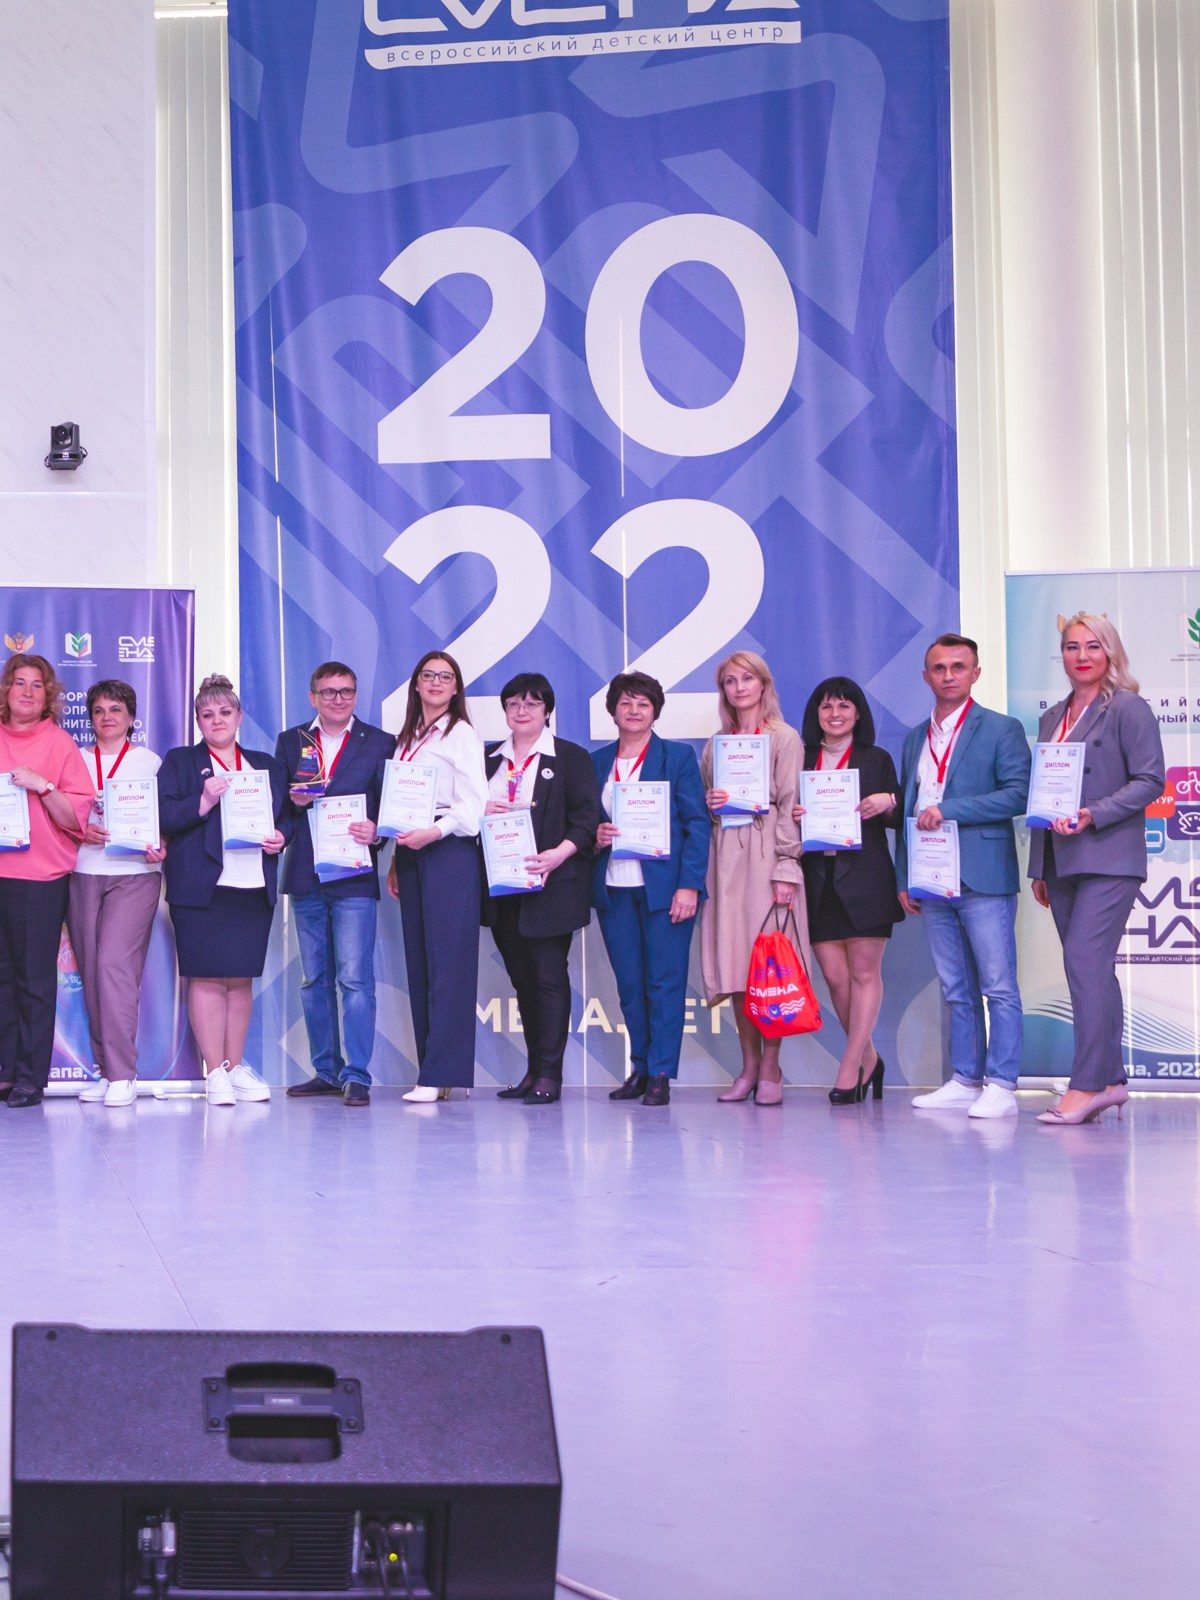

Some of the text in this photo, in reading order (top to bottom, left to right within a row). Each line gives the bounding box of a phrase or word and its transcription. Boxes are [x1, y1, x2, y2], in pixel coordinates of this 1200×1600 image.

[387, 25, 784, 63] всероссийский детский центр
[377, 213, 799, 464] 20
[382, 499, 765, 740] 22
[749, 983, 799, 998] СМЕНА
